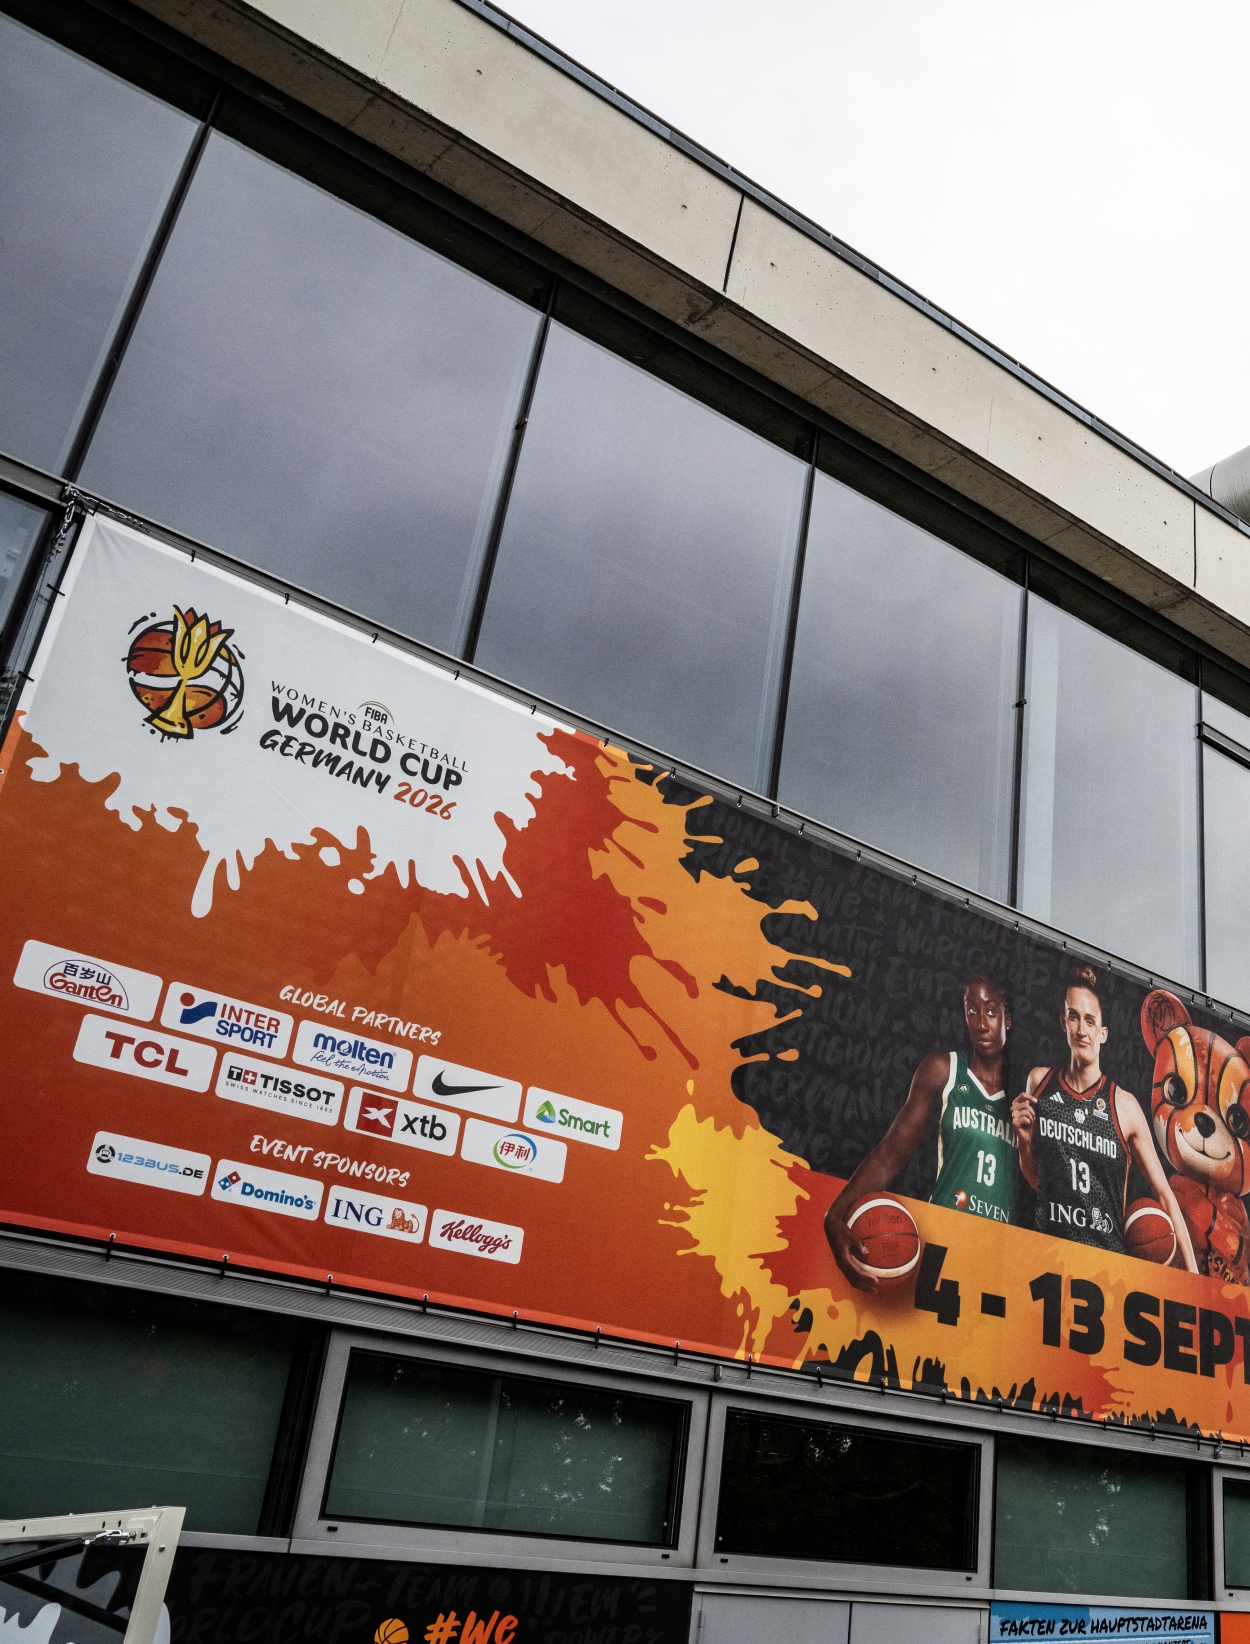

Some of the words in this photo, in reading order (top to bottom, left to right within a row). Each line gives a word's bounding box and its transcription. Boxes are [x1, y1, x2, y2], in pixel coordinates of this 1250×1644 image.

[271, 680, 357, 726] WOMEN'S
[361, 719, 469, 773] BASKETBALL
[364, 706, 388, 725] FIBA
[271, 695, 392, 764] WORLD
[399, 752, 463, 791] CUP
[259, 729, 392, 794] GERMANY
[393, 781, 457, 820] 2026
[63, 962, 112, 986] 百岁山
[220, 1003, 281, 1034] INTER
[279, 985, 347, 1018] GLOBAL
[351, 1006, 441, 1045] PARTNERS
[215, 1019, 277, 1049] SPORT
[312, 1032, 394, 1069] molten
[104, 1031, 189, 1077] TCL
[309, 1050, 334, 1068] feel
[333, 1057, 351, 1069] the
[225, 1081, 250, 1093] SWISS
[252, 1088, 288, 1103] WATCHES
[290, 1097, 315, 1109] SINCE
[260, 1073, 336, 1106] TISSOT
[400, 1113, 447, 1141] xtb
[557, 1108, 611, 1138] Smart
[953, 1106, 1018, 1148] AUSTRALI
[1039, 1116, 1117, 1159] DEUTSCHLAND
[117, 1151, 205, 1180] 123BUS.DE
[249, 1134, 314, 1164] EVENT
[313, 1151, 411, 1187] SPONSORS
[499, 1141, 531, 1161] 伊利
[976, 1150, 997, 1187] 13
[1070, 1158, 1091, 1194] 13
[240, 1181, 315, 1211] Domino's
[330, 1198, 384, 1227] ING
[1049, 1201, 1087, 1228] ING
[439, 1219, 514, 1254] Kellogg's
[914, 1242, 961, 1327] 4
[1030, 1271, 1106, 1356] 13
[423, 1610, 519, 1644] #We
[1000, 1618, 1056, 1637] FAKTEN
[1059, 1618, 1087, 1635] ZUR
[1090, 1615, 1208, 1634] HAUPTSTADTARENA
